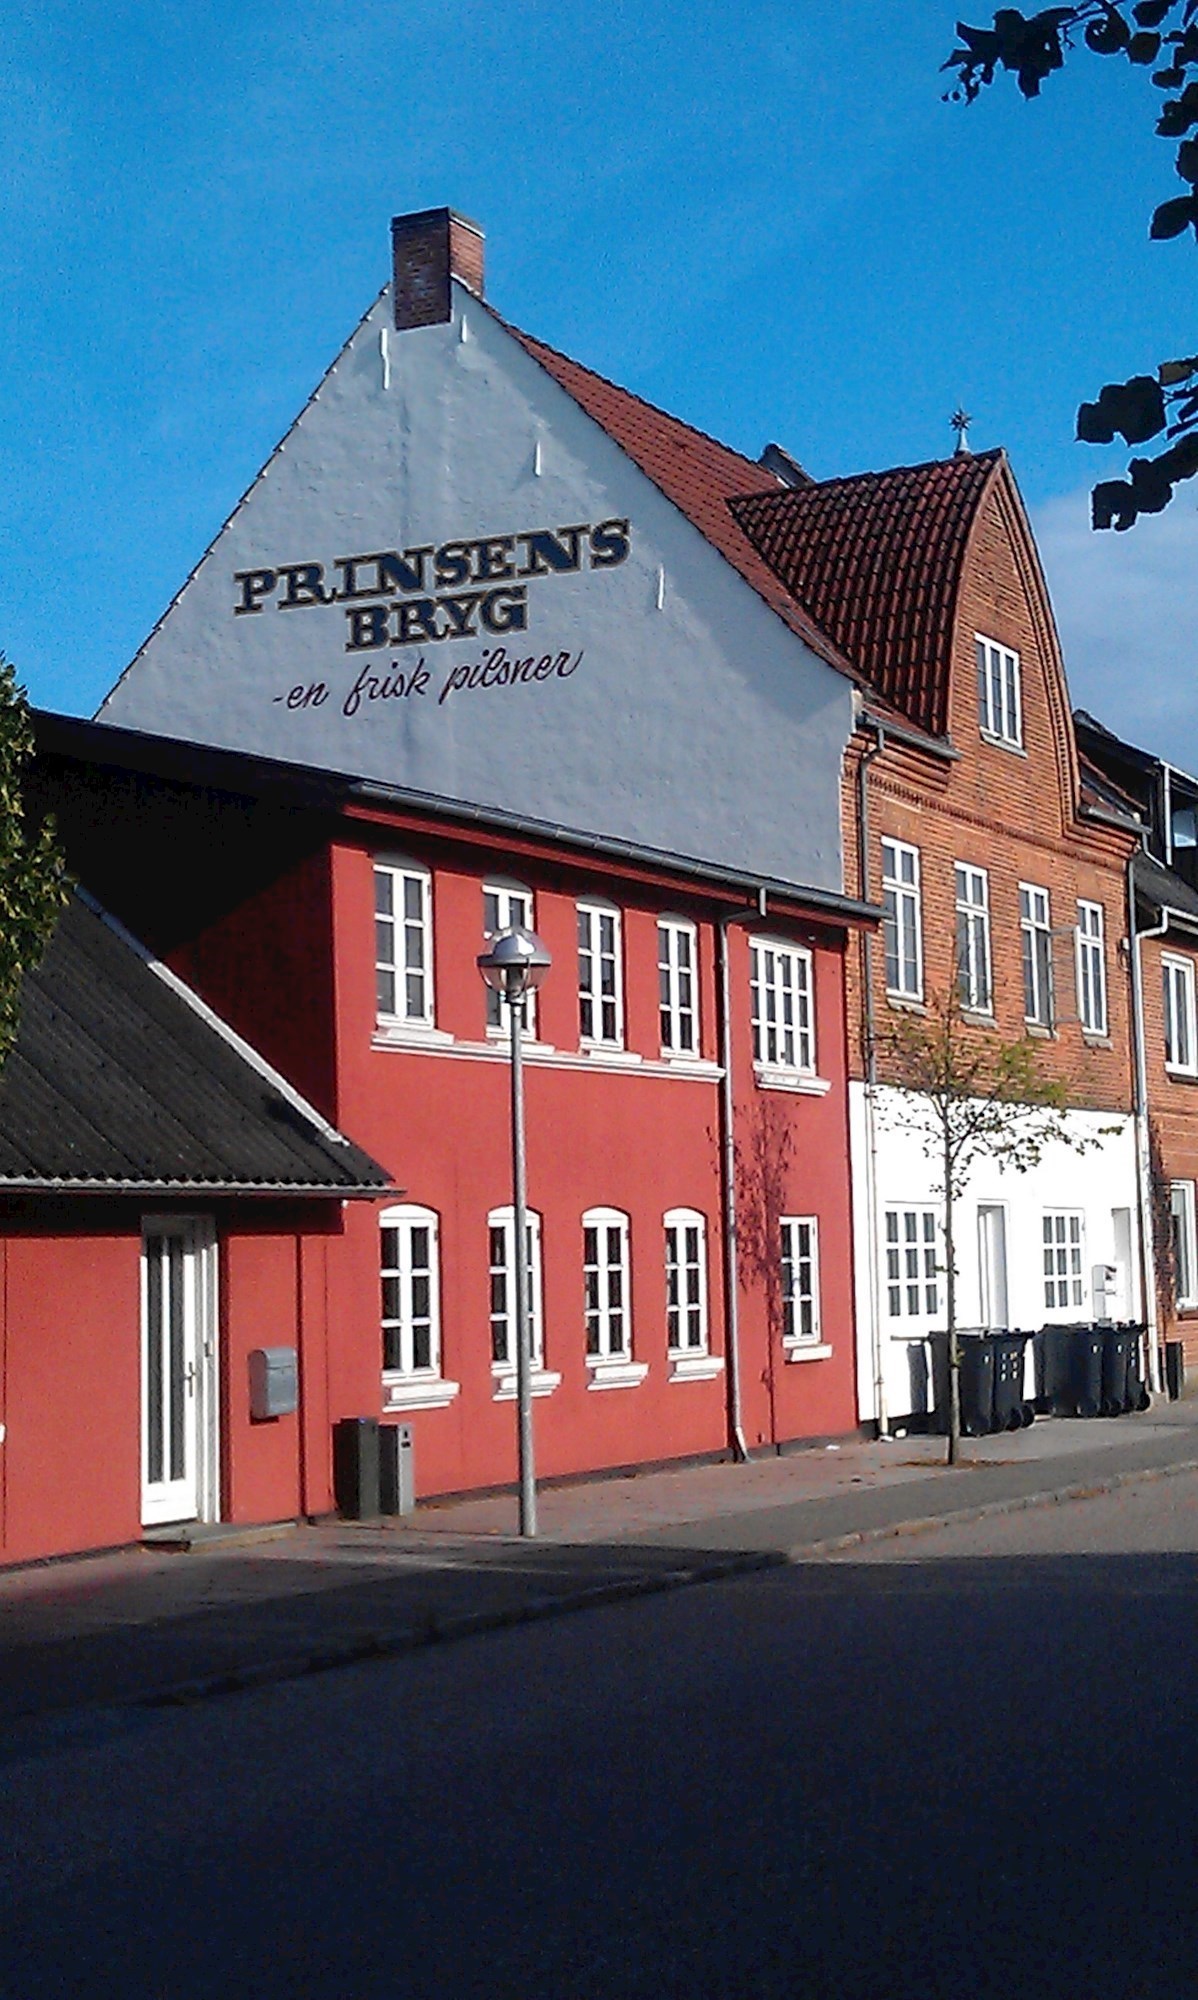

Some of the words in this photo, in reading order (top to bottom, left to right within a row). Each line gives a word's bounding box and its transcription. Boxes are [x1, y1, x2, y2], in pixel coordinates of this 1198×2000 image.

[234, 518, 632, 615] PRINSENS
[345, 586, 528, 652] BRYG
[343, 657, 430, 717] frisk
[439, 648, 585, 704] pilsner
